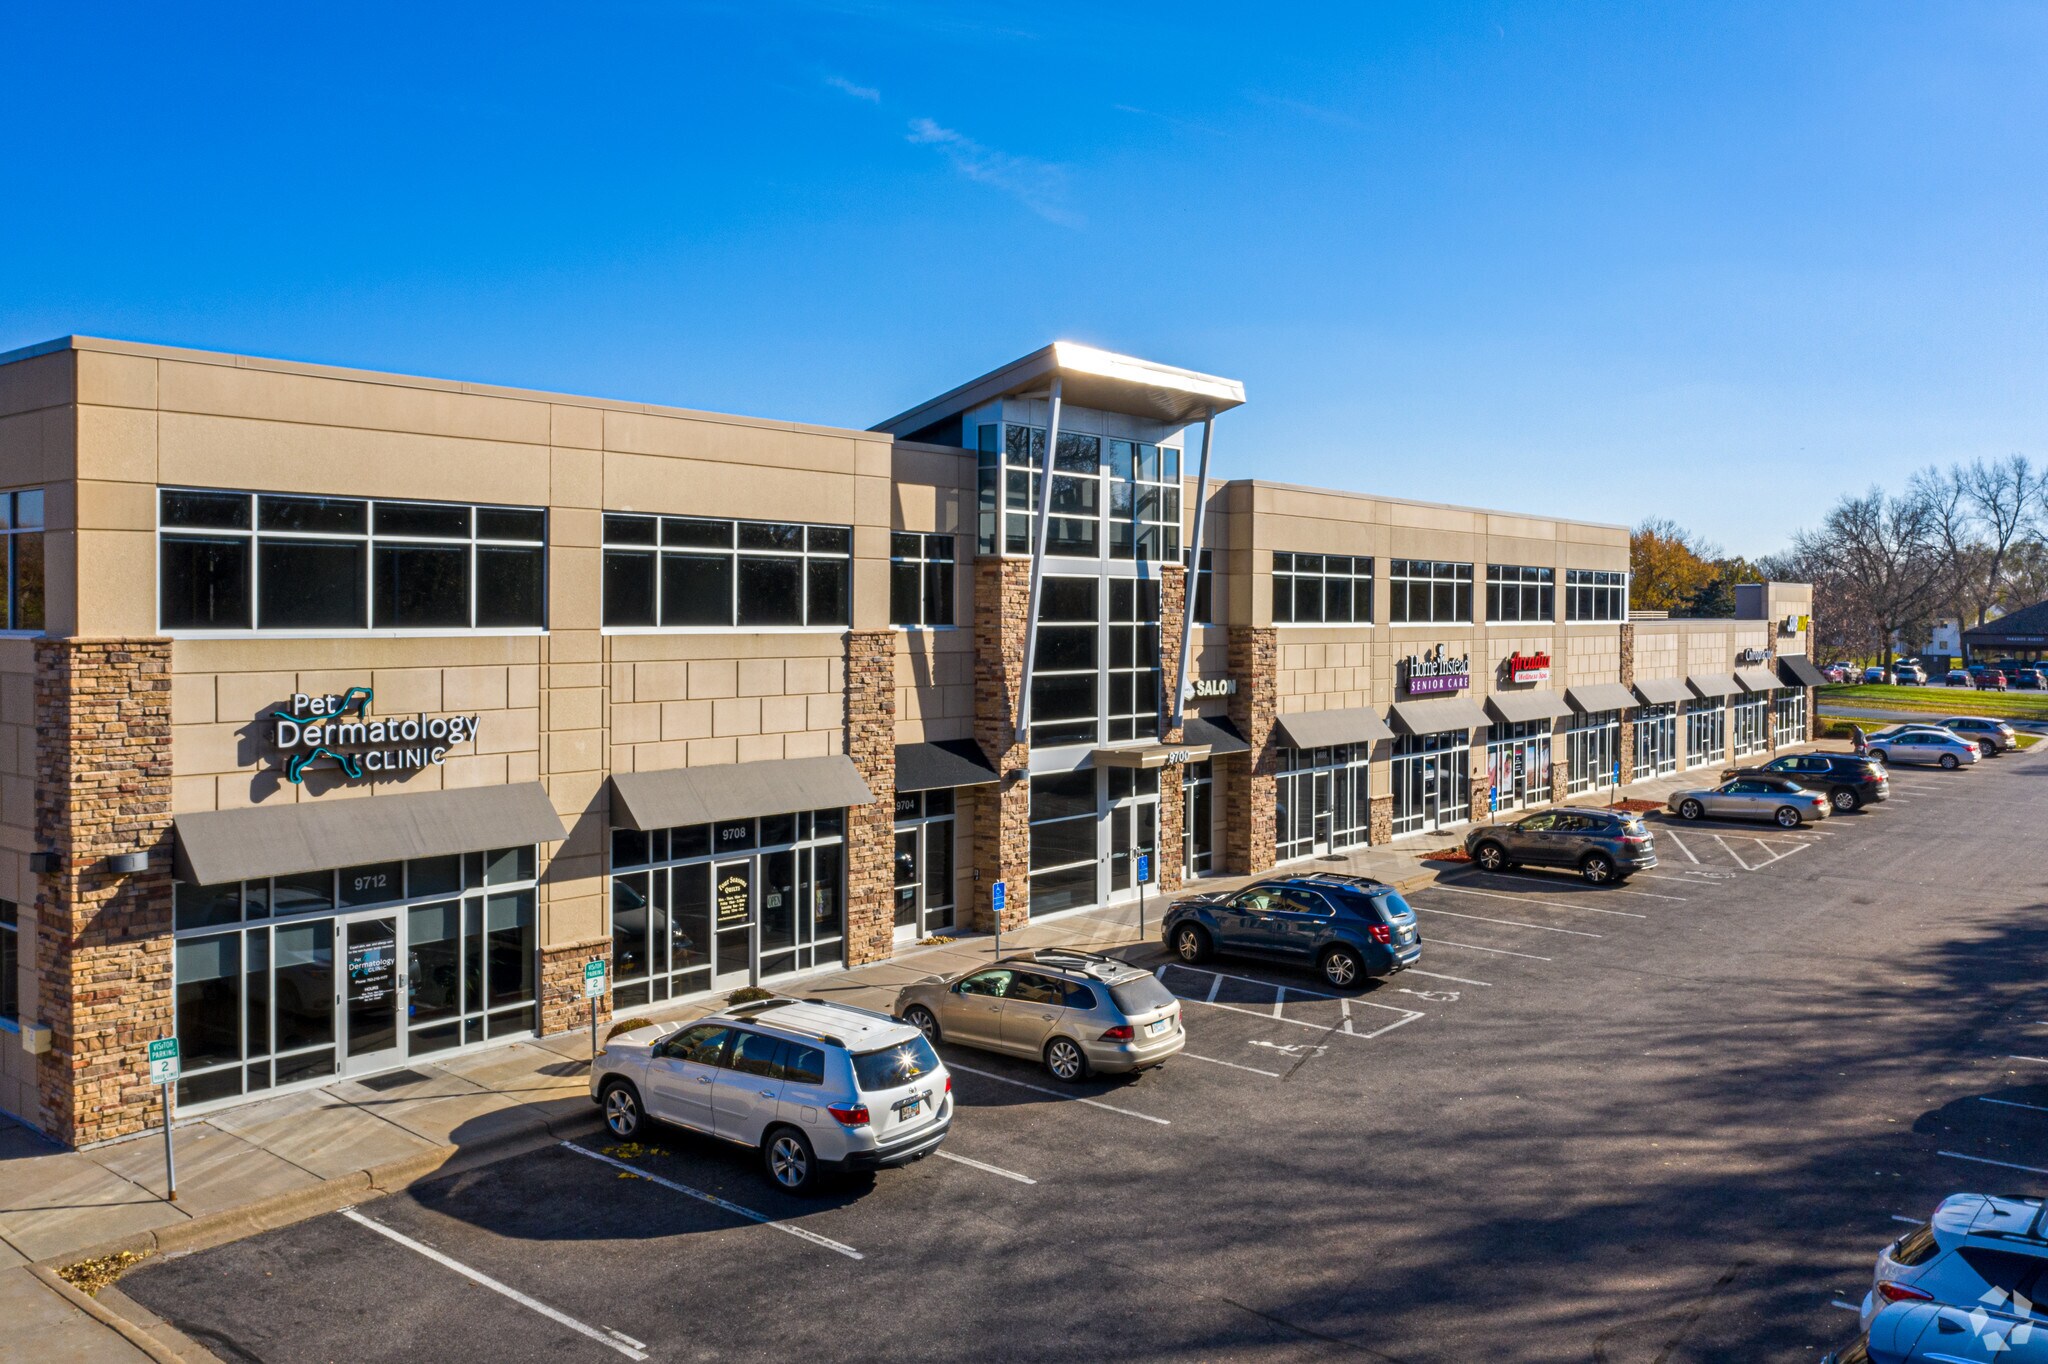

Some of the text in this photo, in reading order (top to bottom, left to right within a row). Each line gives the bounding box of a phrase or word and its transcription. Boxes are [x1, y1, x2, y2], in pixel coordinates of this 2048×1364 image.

[1410, 653, 1469, 677] Home Instead
[1511, 651, 1550, 681] Arcadia
[1197, 680, 1236, 696] SALON
[1411, 677, 1468, 691] SENIOR CARE
[294, 694, 336, 715] Pet
[278, 713, 480, 748] Dermatology
[365, 747, 446, 771] CLINIC
[1169, 751, 1190, 763] 9700
[896, 799, 914, 811] 9704
[722, 827, 746, 840] 9708
[354, 874, 387, 891] 9712
[349, 958, 395, 971] Dermatology
[367, 965, 387, 973] CLINIC
[592, 979, 598, 988] 2
[153, 1041, 174, 1051] VISITOR
[152, 1048, 176, 1060] PARKING
[161, 1061, 169, 1072] 2
